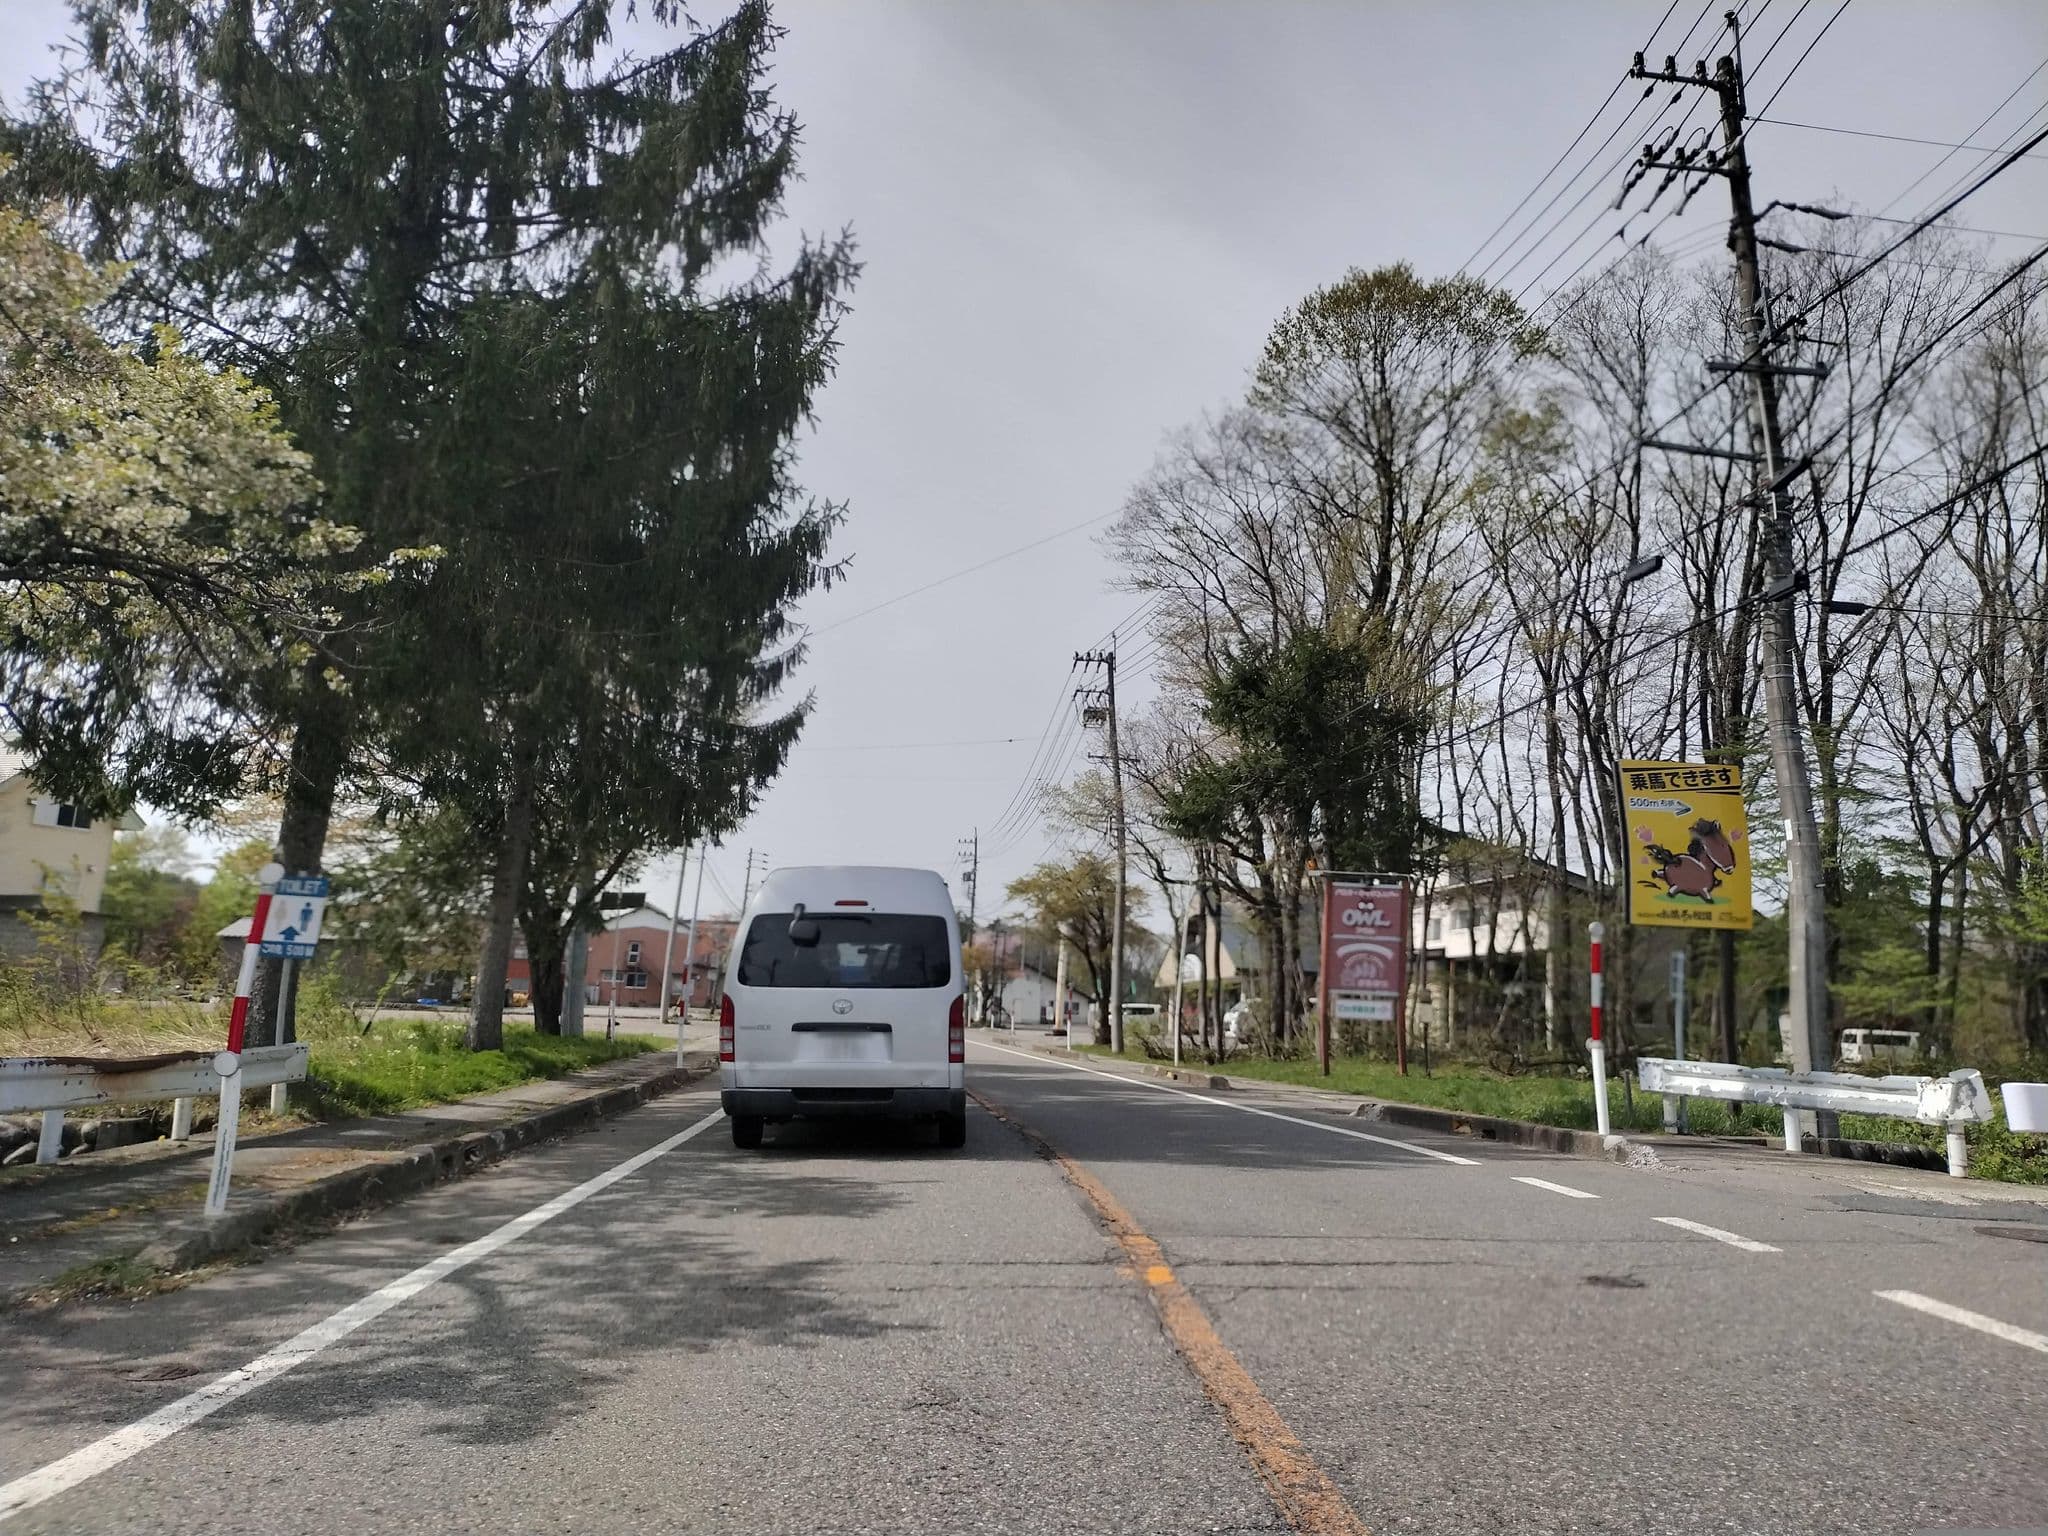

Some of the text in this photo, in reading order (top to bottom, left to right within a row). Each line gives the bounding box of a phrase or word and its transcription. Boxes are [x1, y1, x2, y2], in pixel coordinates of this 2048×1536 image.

[1630, 768, 1731, 790] 乗馬できます
[1342, 908, 1392, 927] OWL
